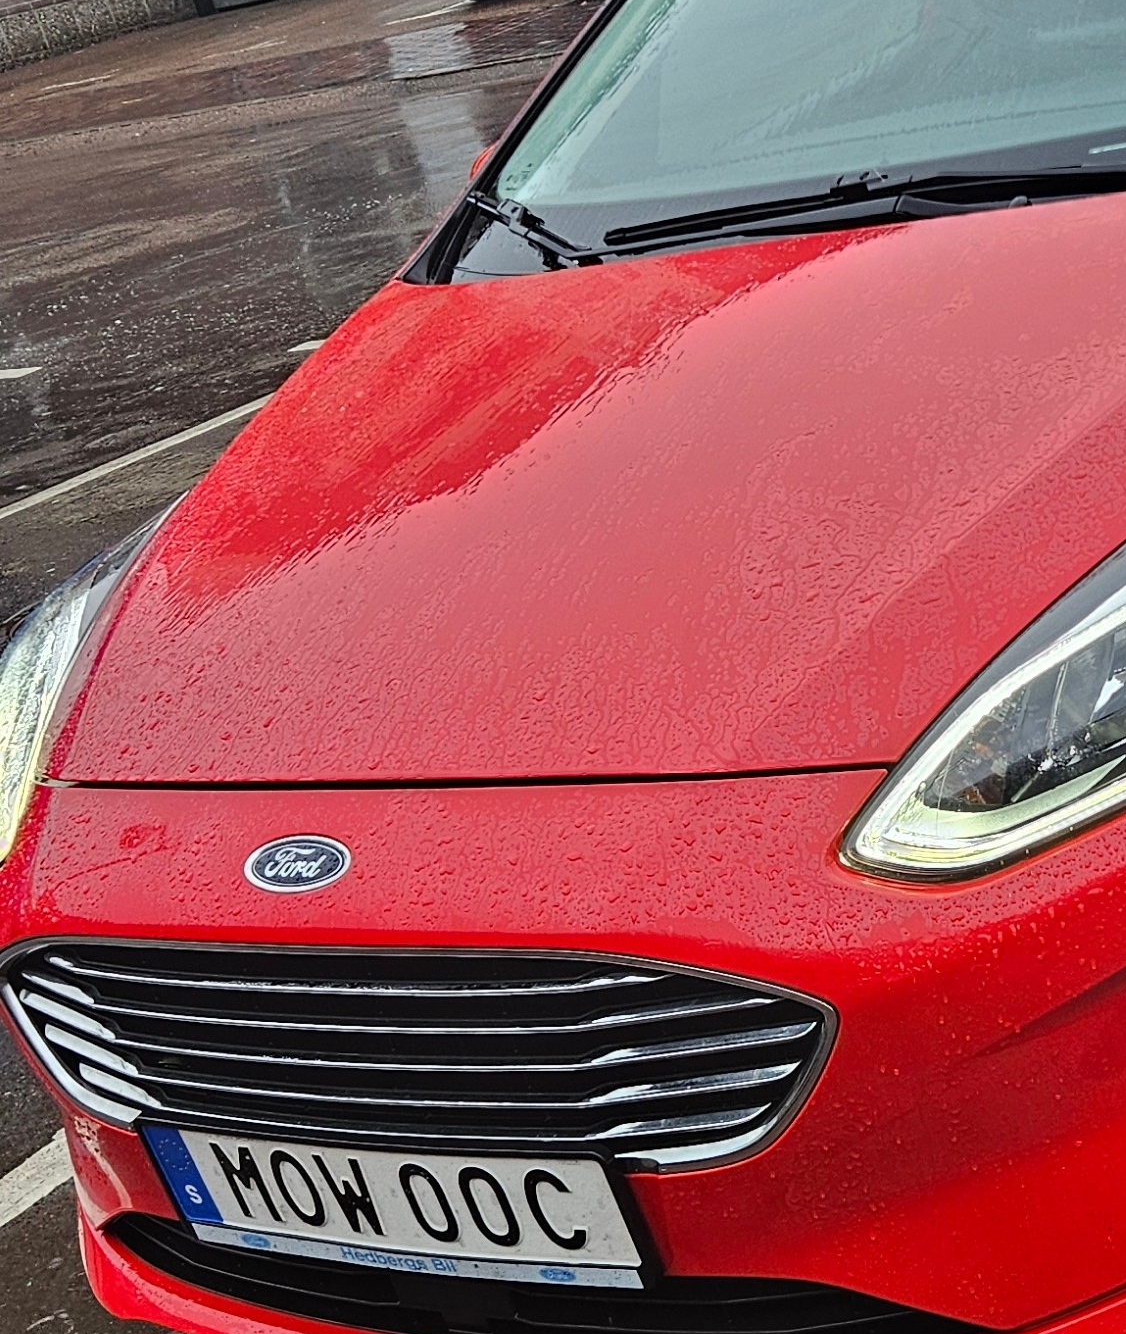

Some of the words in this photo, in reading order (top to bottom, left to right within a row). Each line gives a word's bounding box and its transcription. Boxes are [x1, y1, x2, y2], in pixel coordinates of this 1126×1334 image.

[264, 847, 327, 878] Ford
[184, 1184, 203, 1204] S
[209, 1142, 386, 1236] MOW
[340, 1247, 428, 1271] Hedbergs
[431, 1259, 457, 1273] Bil
